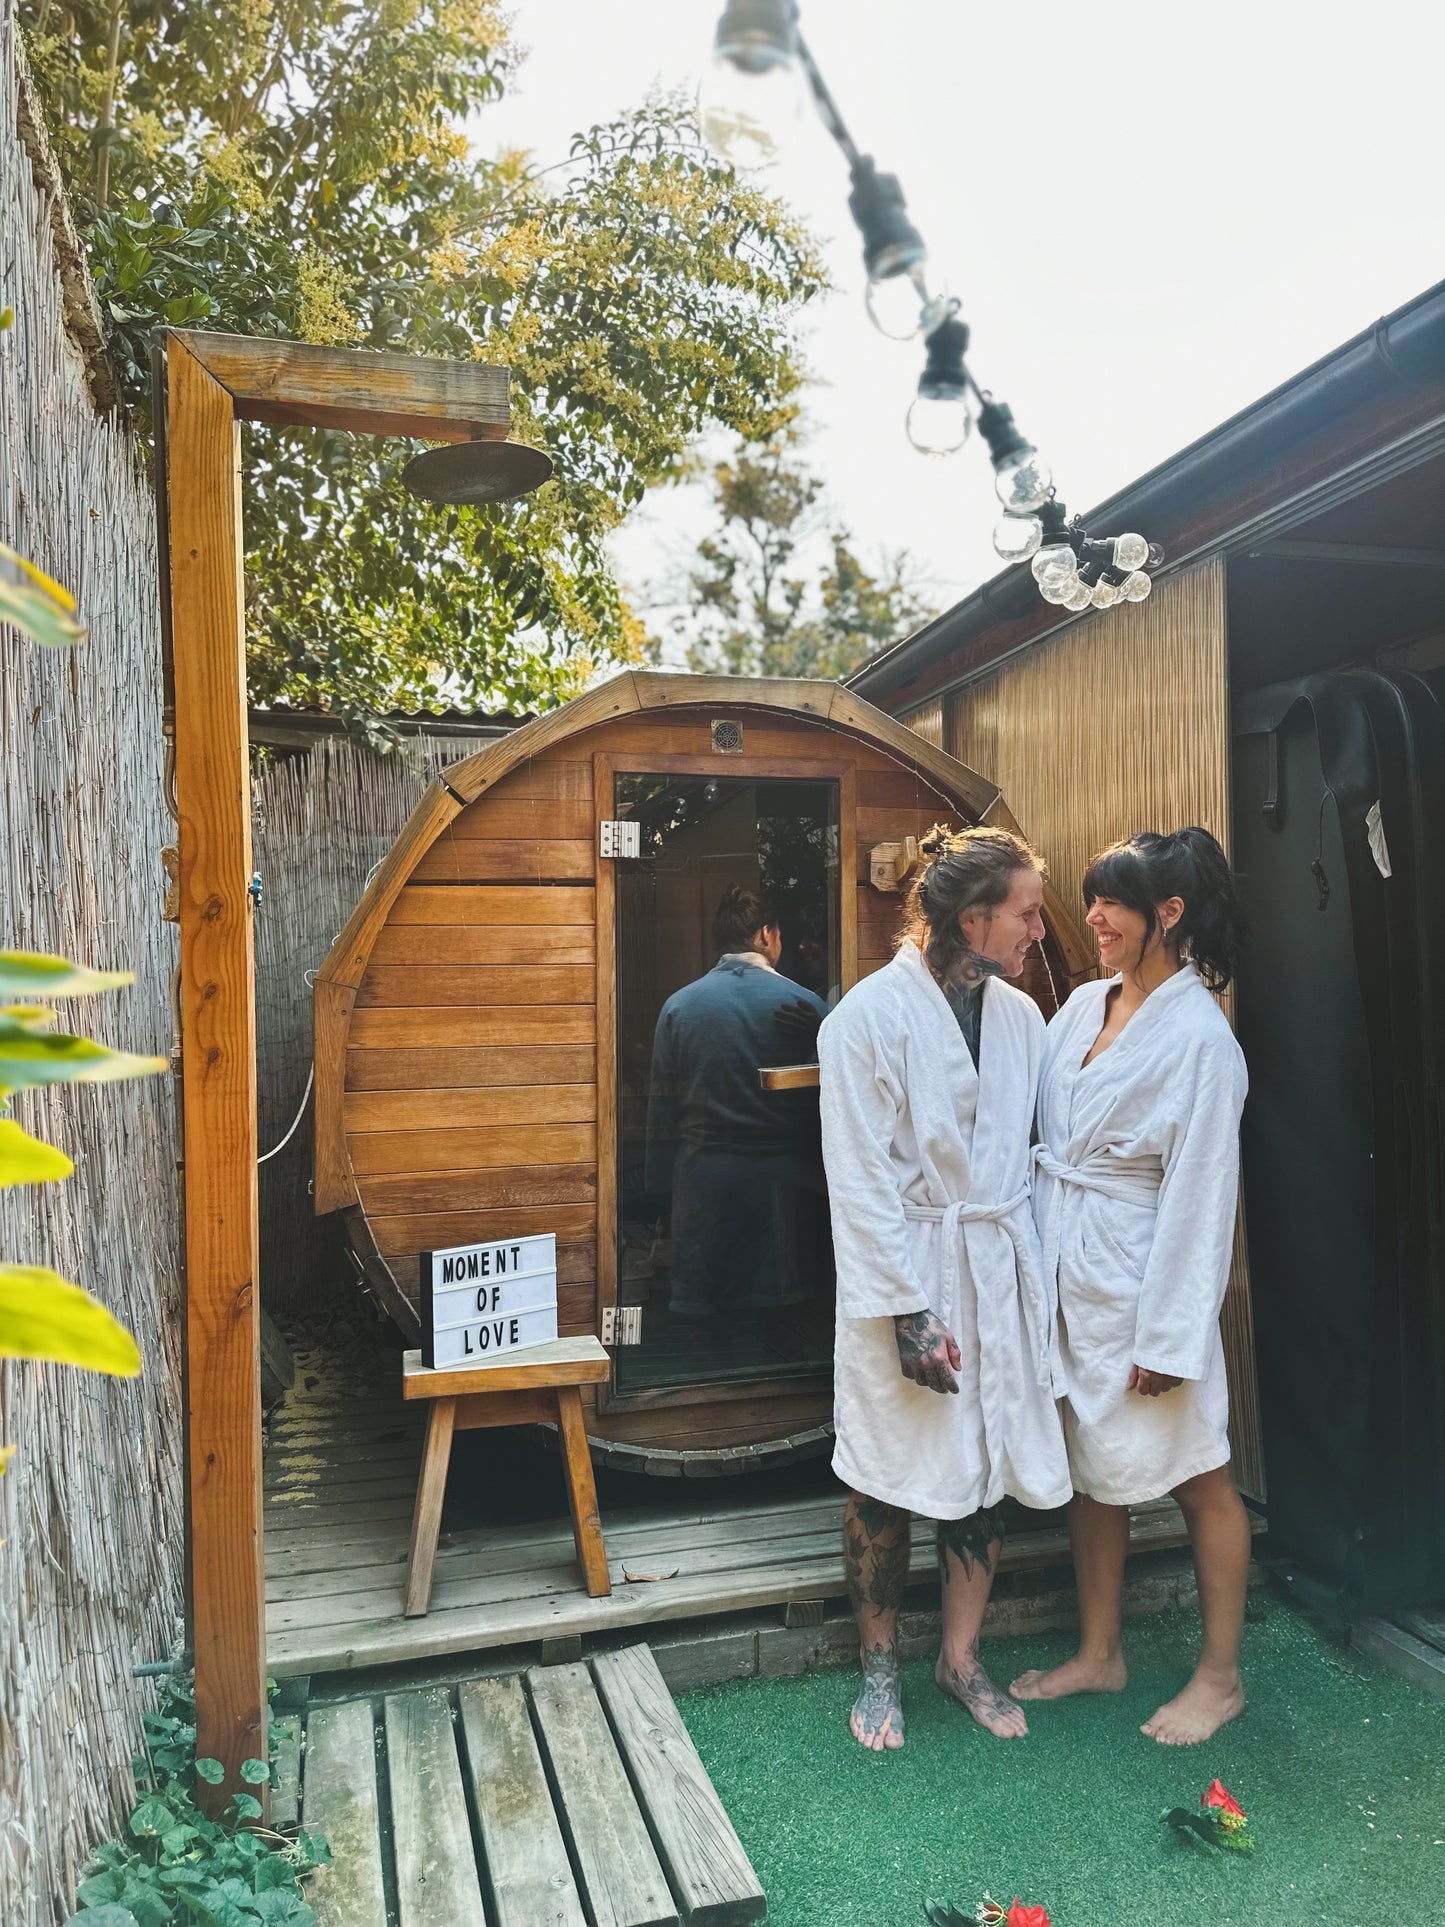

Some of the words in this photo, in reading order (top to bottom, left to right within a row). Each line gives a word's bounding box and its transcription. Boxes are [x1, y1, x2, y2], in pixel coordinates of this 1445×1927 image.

[443, 1247, 520, 1284] MOMENT
[477, 1287, 500, 1312] OF
[464, 1319, 519, 1354] LOVE
